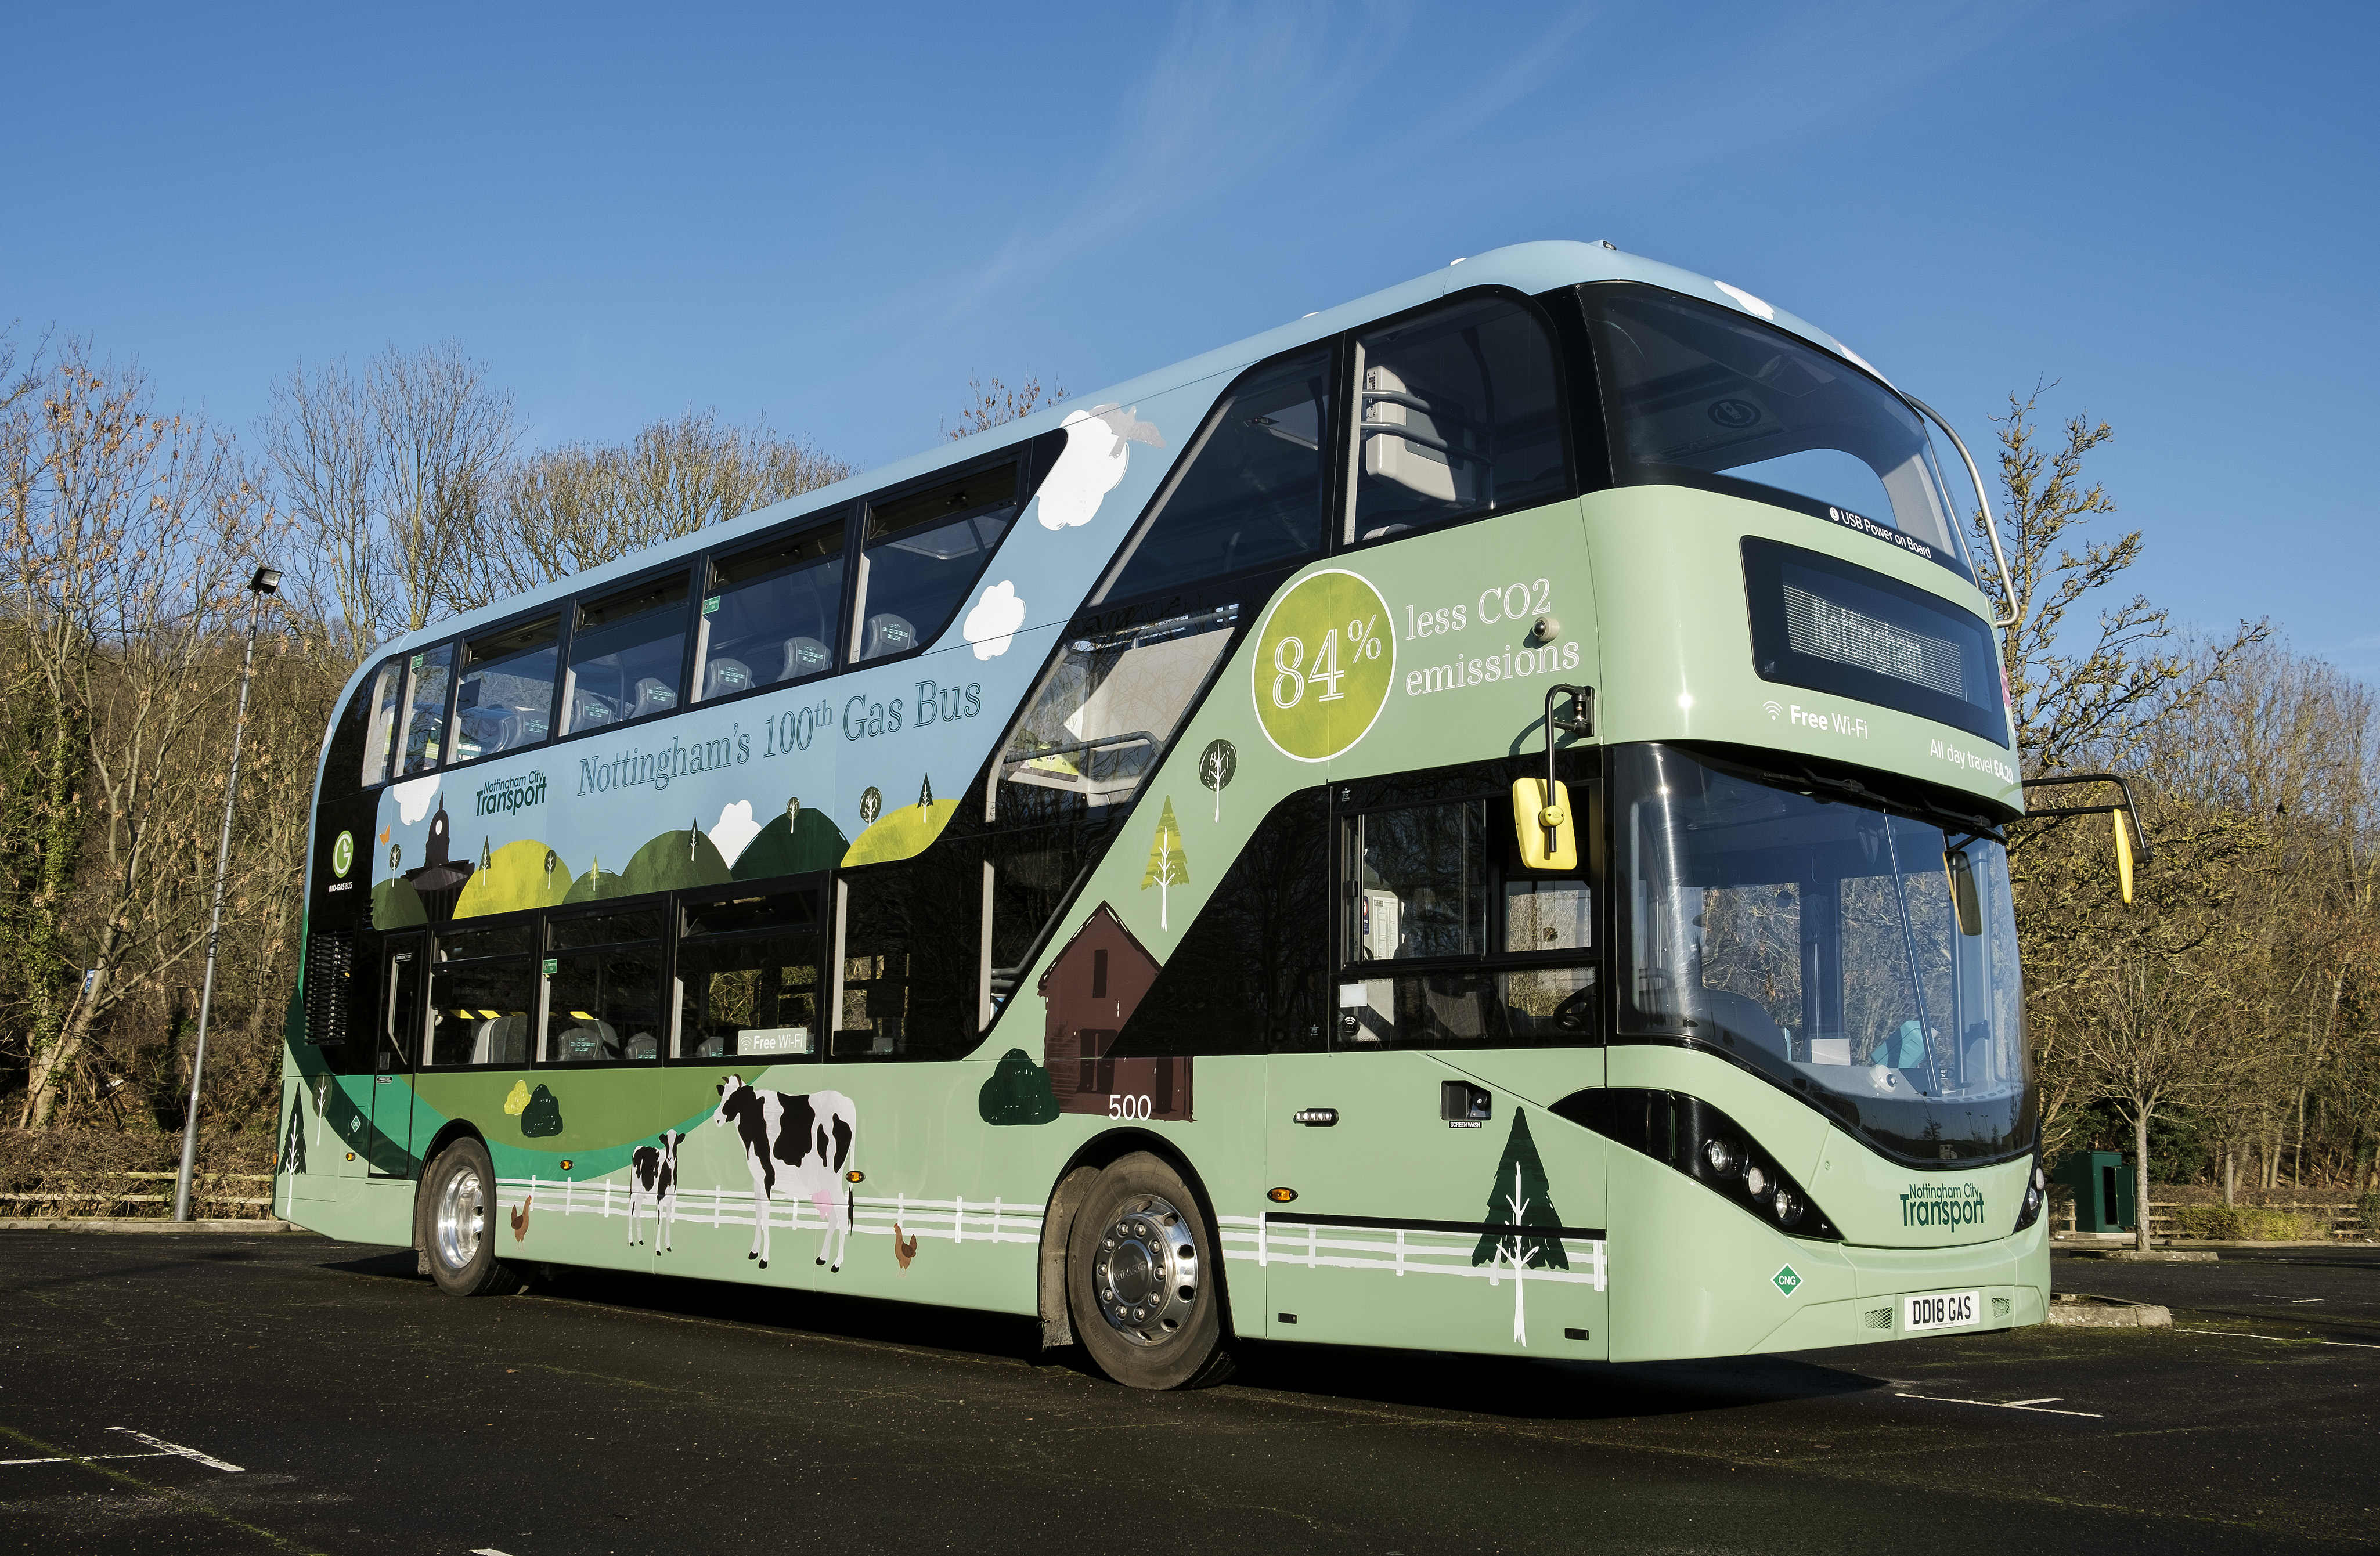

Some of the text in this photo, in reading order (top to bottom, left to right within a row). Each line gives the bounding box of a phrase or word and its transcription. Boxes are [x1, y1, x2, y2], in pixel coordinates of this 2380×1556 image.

[1841, 510, 1931, 559] USB Power on Board
[1405, 578, 1552, 641] less CO2
[1814, 598, 1923, 678] Nottingham
[1272, 614, 1382, 709] 84%
[1405, 641, 1580, 696] emissions
[763, 699, 834, 758] 100th
[842, 694, 903, 741] Gas
[913, 680, 981, 728] Bus
[1790, 704, 1868, 739] Free Wi-Fi
[1930, 739, 2014, 785] All day travel £4.20
[476, 776, 547, 817] Transport
[484, 770, 544, 794] Nottingham City
[329, 883, 345, 892] BIO-GAS
[753, 1033, 803, 1050] Free Wi-Fi
[1108, 1094, 1151, 1121] 500
[1909, 1182, 1979, 1204] Nottingham City
[1900, 1192, 1984, 1233] Transport
[1113, 1261, 1146, 1281] SCANIA
[1779, 1275, 1796, 1286] CNG
[1913, 1295, 1971, 1325] DD18 GAS
